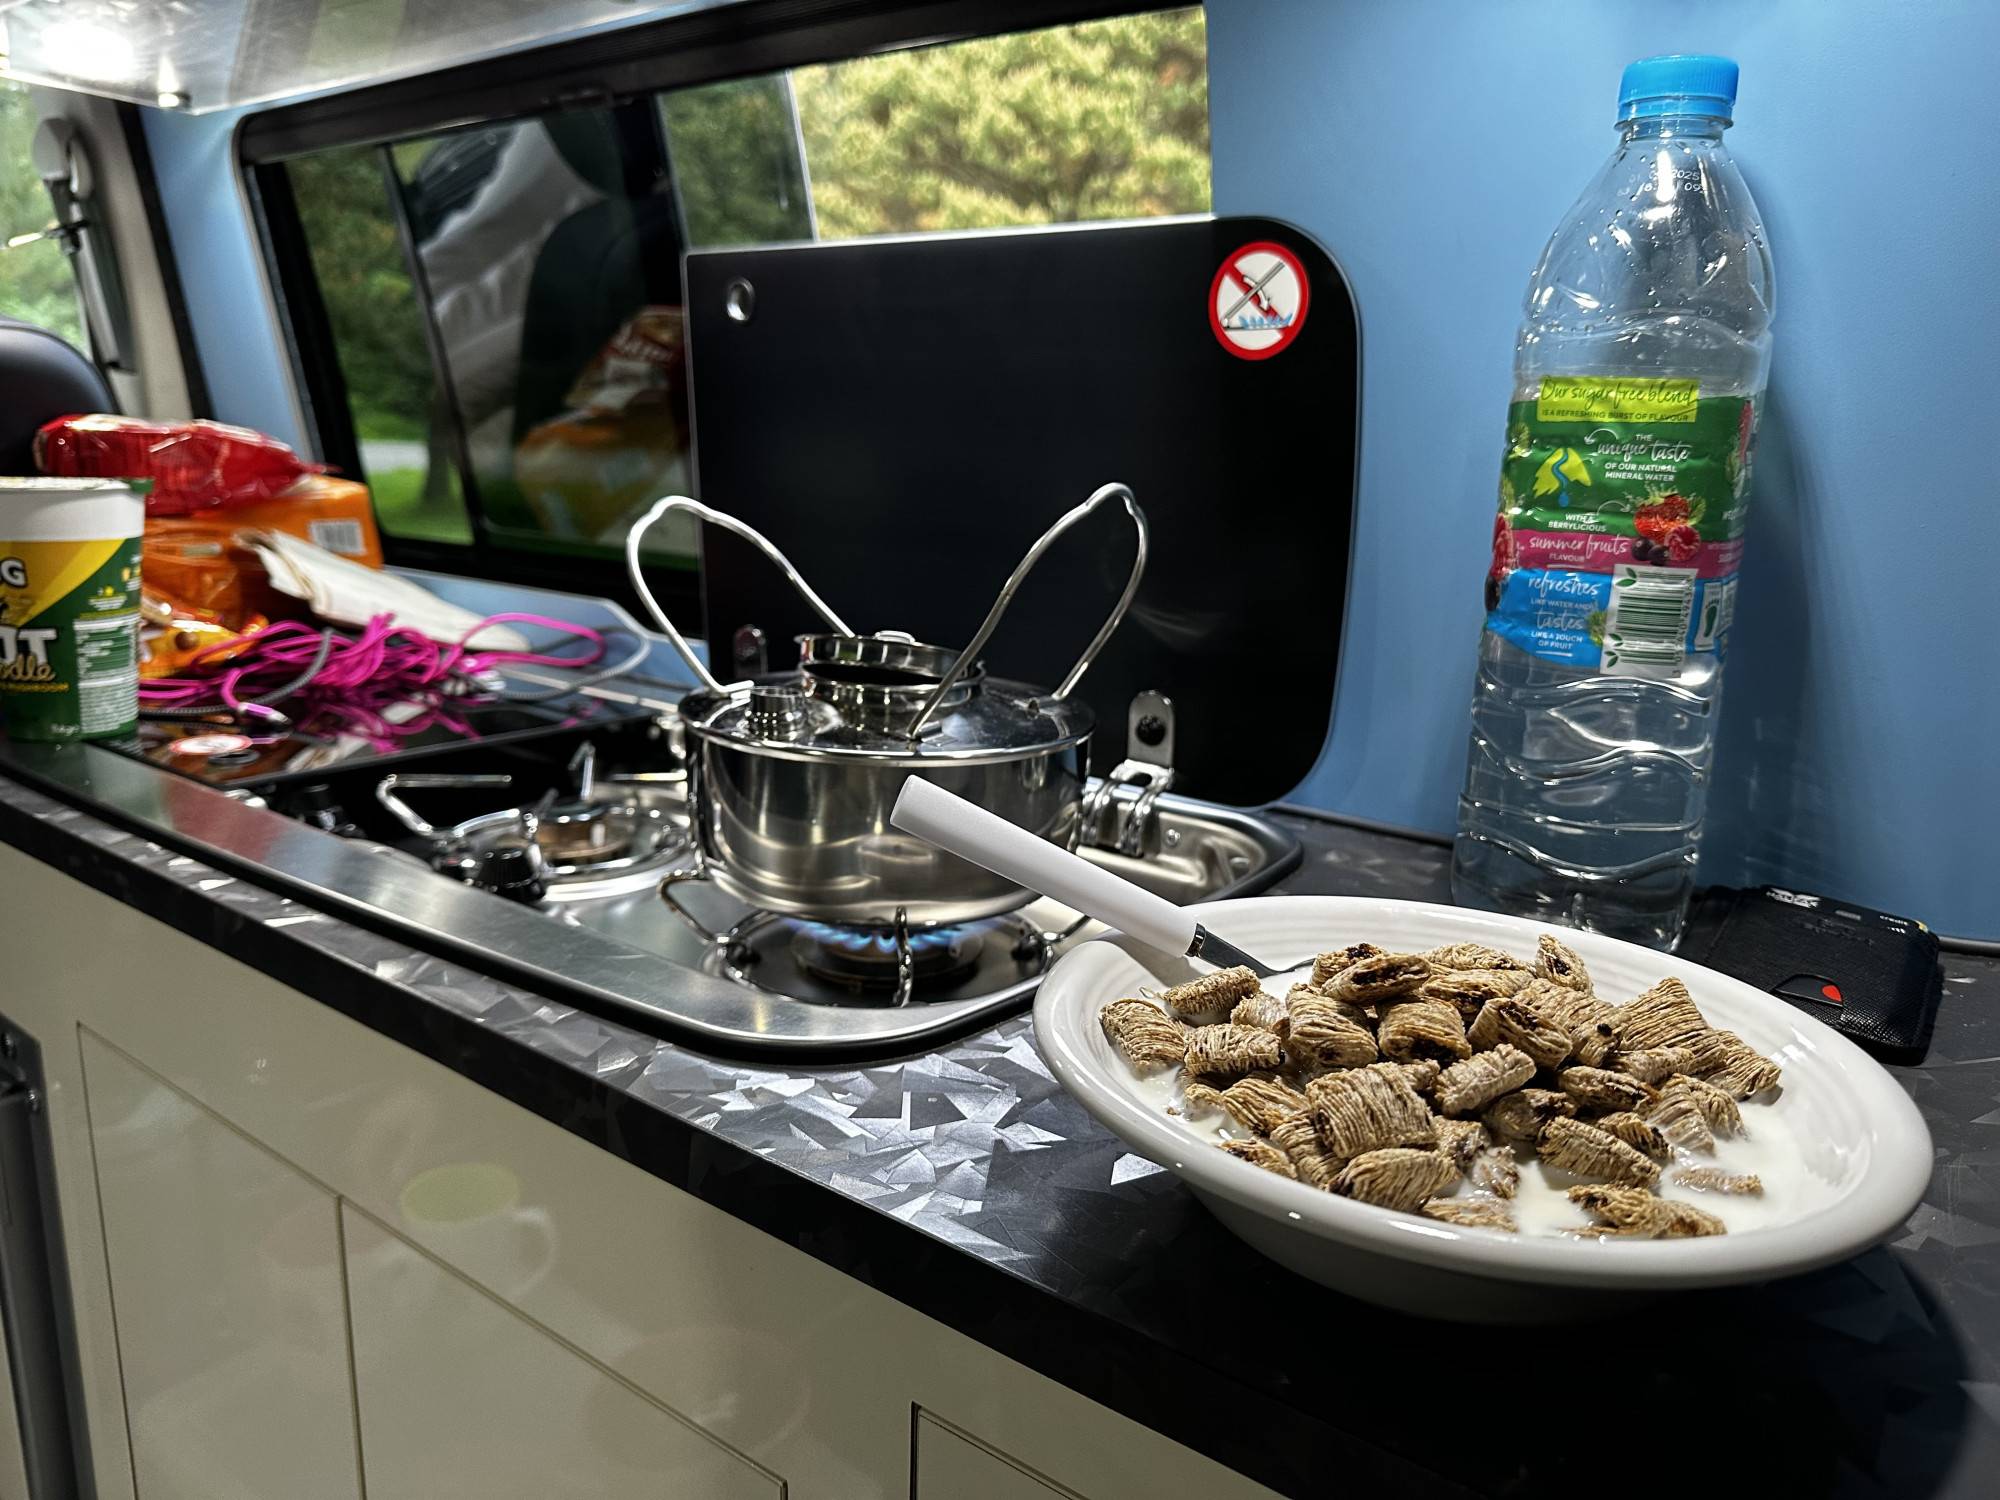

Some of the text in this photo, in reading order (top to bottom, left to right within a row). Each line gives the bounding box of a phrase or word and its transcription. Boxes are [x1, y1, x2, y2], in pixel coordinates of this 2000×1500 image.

[1571, 386, 1614, 410] sugar
[1613, 380, 1646, 410] free
[1648, 382, 1698, 406] blend
[1556, 409, 1606, 418] REFRESHING
[1608, 411, 1634, 420] BURST
[1634, 412, 1648, 420] OF
[1648, 413, 1689, 421] FLAVOUR
[1597, 439, 1692, 462] unique taste
[1604, 462, 1678, 473] OF OUR NATURAL
[1604, 471, 1675, 482] MINERAL WATER
[1565, 513, 1585, 521] WITH
[1547, 520, 1607, 533] BERRYLICIOUS
[1529, 533, 1633, 559] summer fruits
[1548, 552, 1585, 562] FLAVOUR
[1528, 571, 1602, 598] refreshes
[1547, 600, 1577, 608] WATER
[1533, 607, 1585, 631] tastes
[1530, 631, 1549, 639] LIKE
[1538, 639, 1573, 650] OF FRUIT
